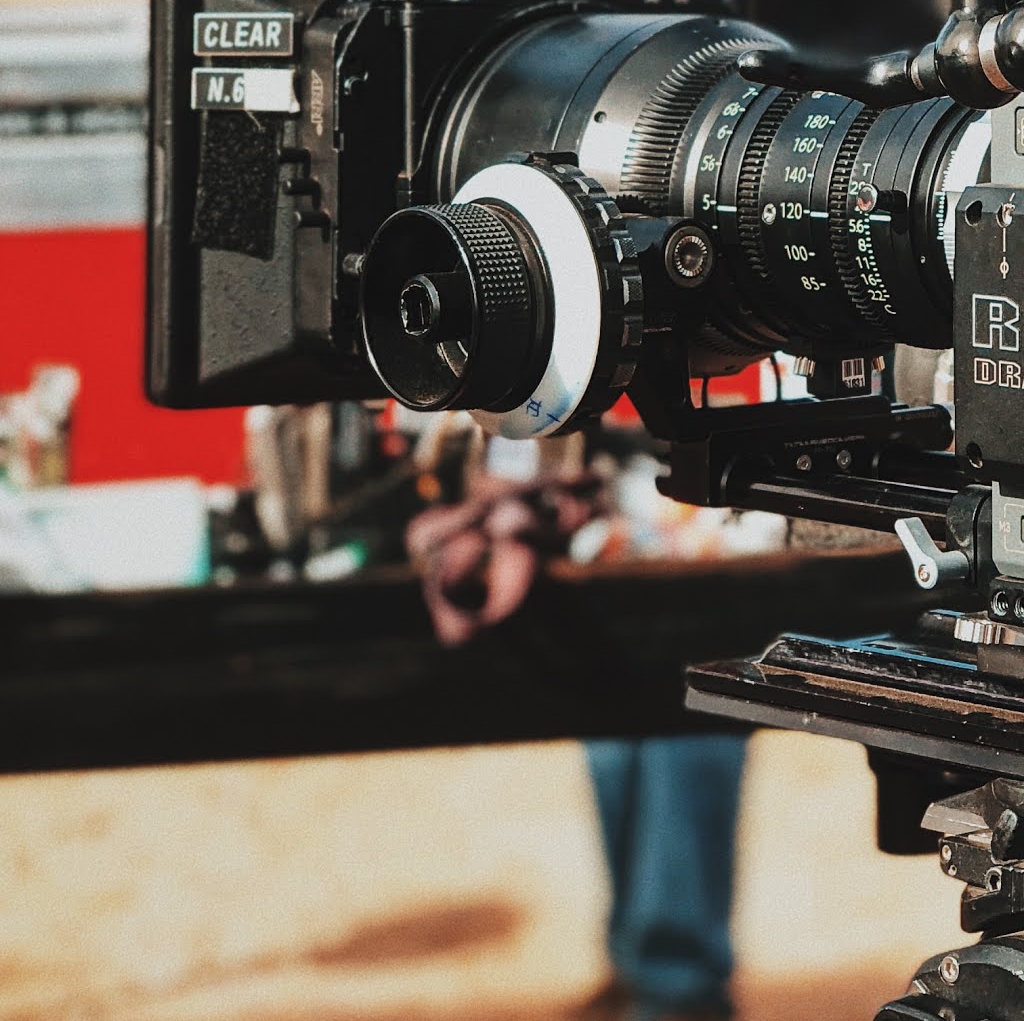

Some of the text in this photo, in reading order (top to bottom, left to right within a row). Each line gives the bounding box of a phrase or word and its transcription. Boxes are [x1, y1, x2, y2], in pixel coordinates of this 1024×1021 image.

[204, 21, 282, 48] CLEAR
[803, 115, 830, 129] 180
[717, 125, 728, 139] 6
[793, 137, 817, 153] 160
[784, 166, 807, 183] 140
[862, 163, 872, 176] T
[702, 194, 711, 210] 5
[780, 202, 803, 219] 120
[857, 238, 867, 252] 8
[784, 244, 808, 262] 100
[856, 256, 870, 270] 11
[801, 276, 820, 290] 85
[861, 273, 877, 286] 16
[868, 290, 887, 301] 22
[999, 521, 1011, 533] M3
